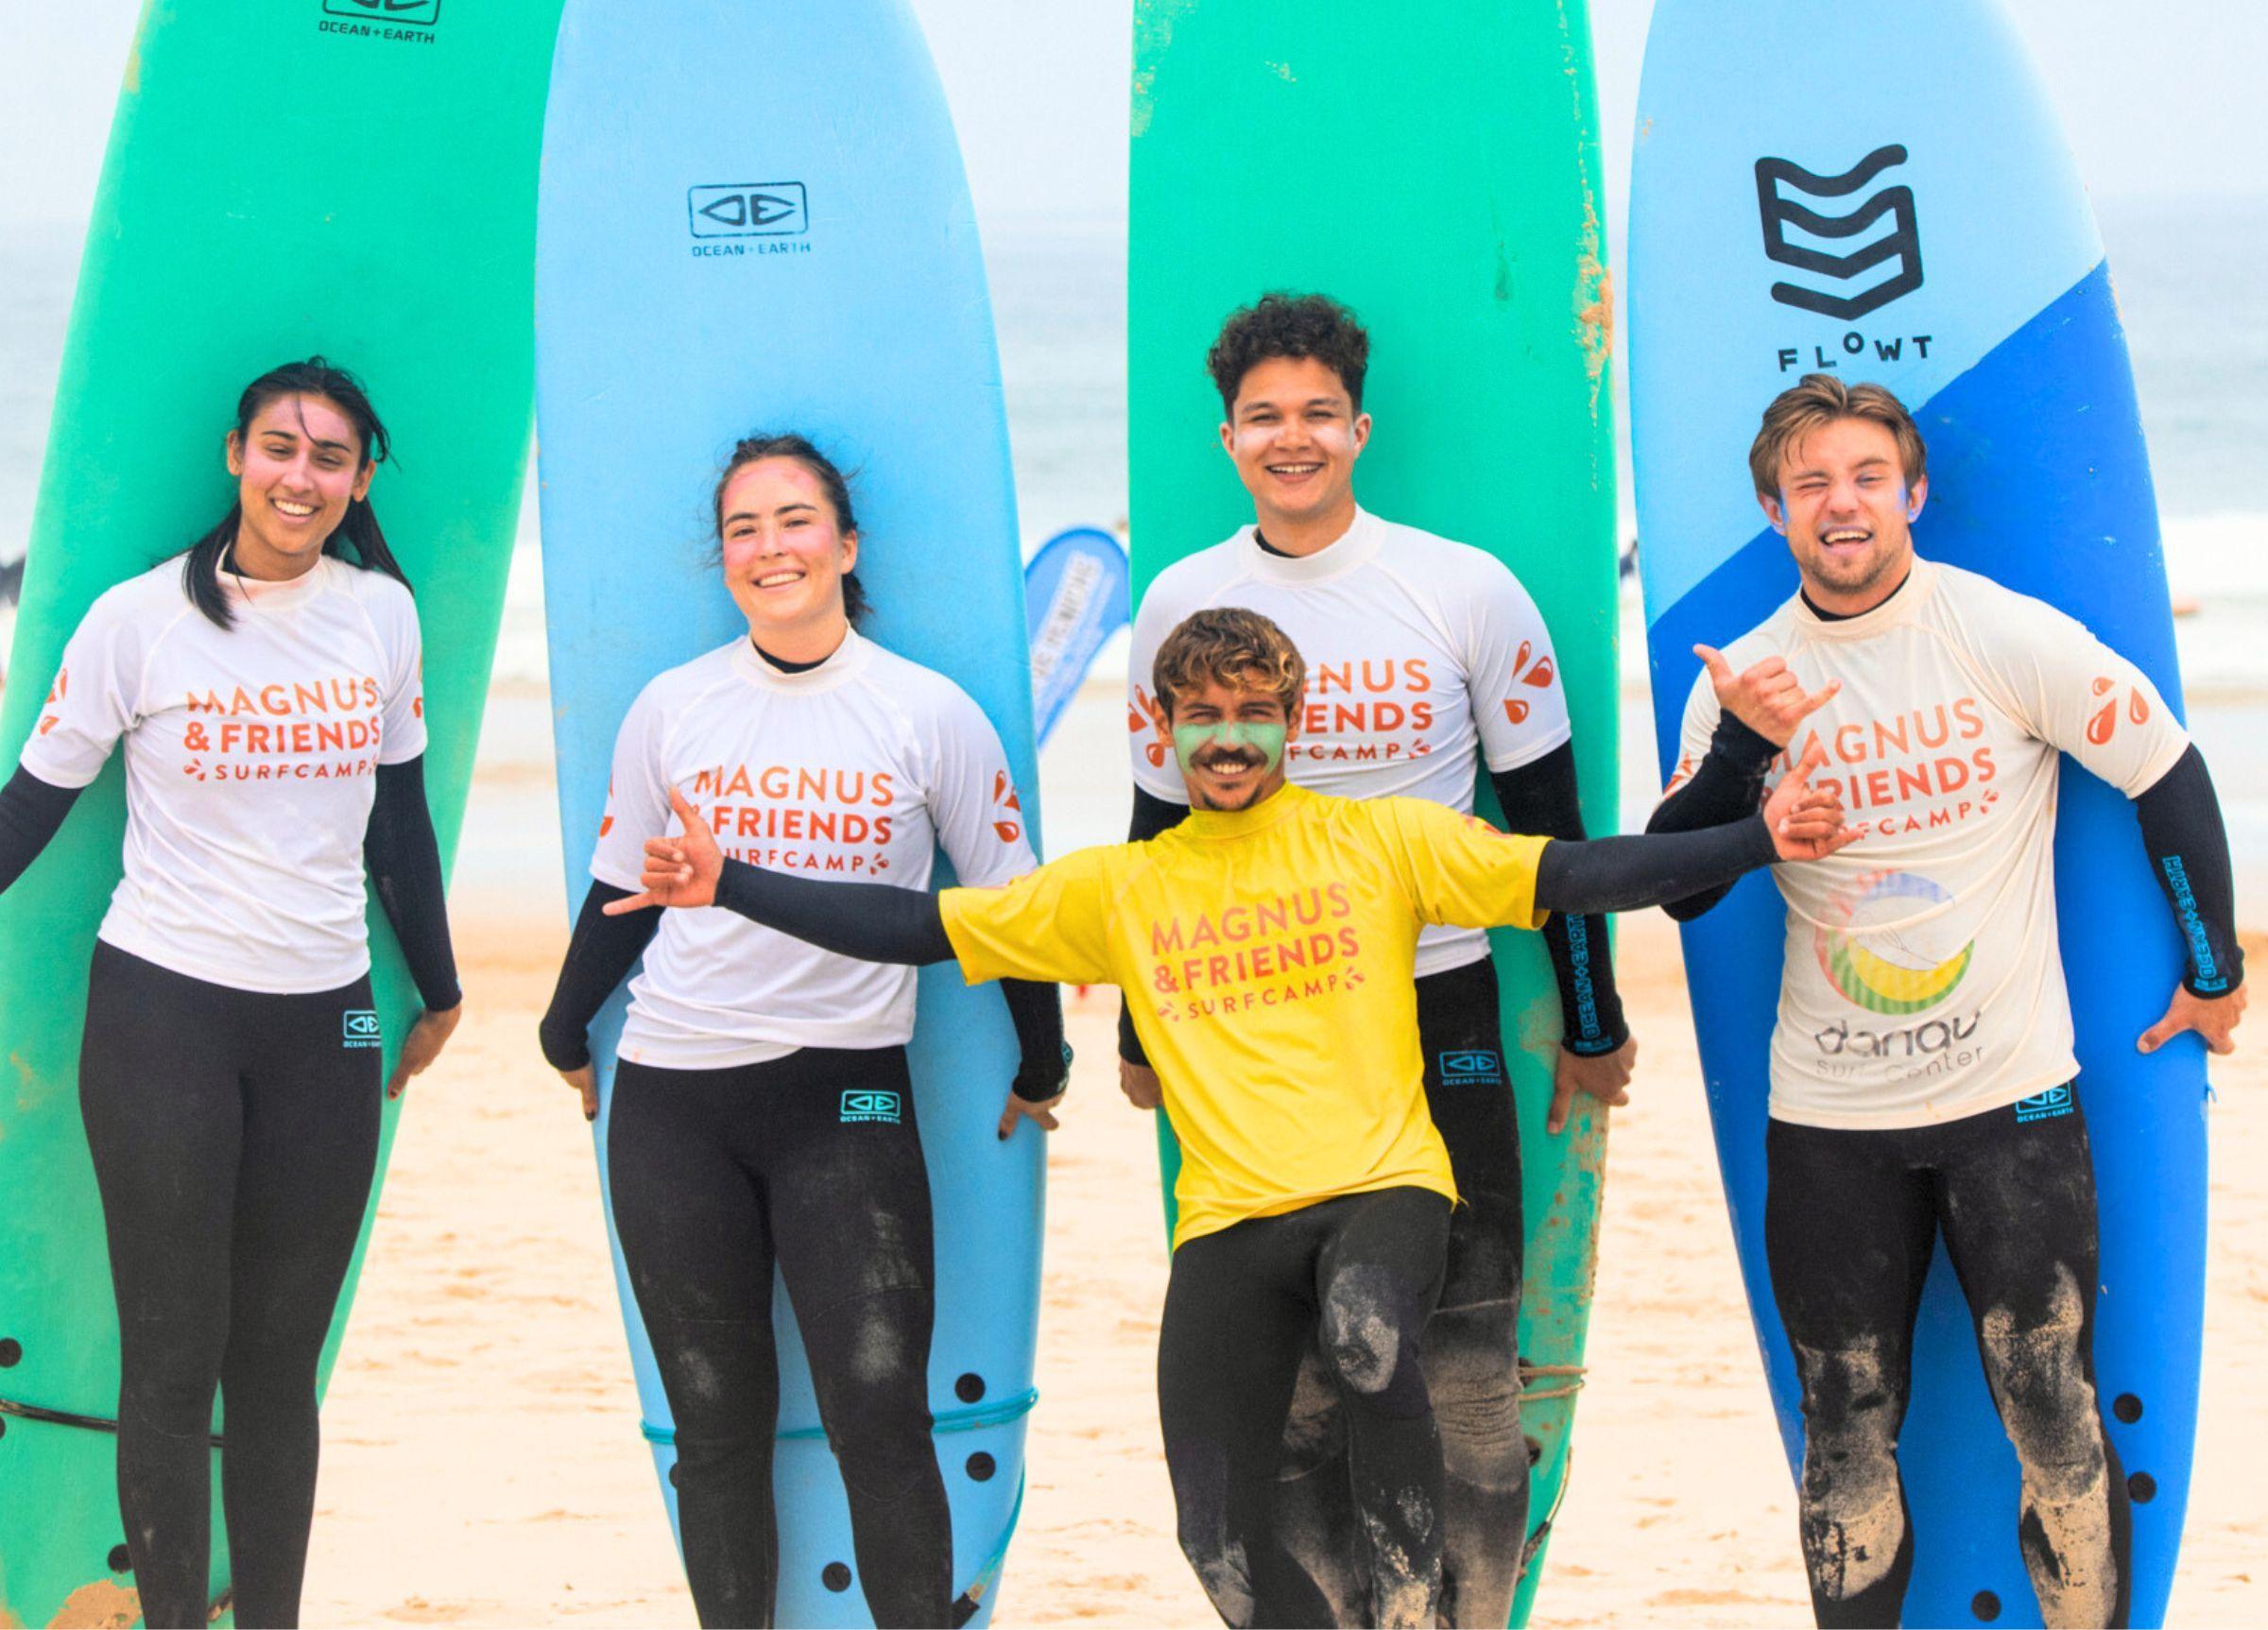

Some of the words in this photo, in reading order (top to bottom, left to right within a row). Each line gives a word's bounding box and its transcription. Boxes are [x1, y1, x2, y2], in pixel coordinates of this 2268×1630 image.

[1778, 331, 1933, 372] FLOWT
[186, 677, 378, 716] MAGNUS
[1304, 659, 1432, 695] NUS
[183, 721, 211, 752] &
[220, 715, 379, 753] FRIENDS
[1305, 701, 1433, 734] ENDS
[215, 759, 369, 781] SURFCAMP
[1288, 743, 1400, 761] FCAMP
[694, 764, 894, 807] MAGNUS
[713, 806, 893, 845] FRIENDS
[725, 848, 864, 872] URFCAMP
[1151, 882, 1351, 957] MAGNUS
[1183, 926, 1360, 990] FRIENDS
[1188, 973, 1338, 1020] SURFCAMP
